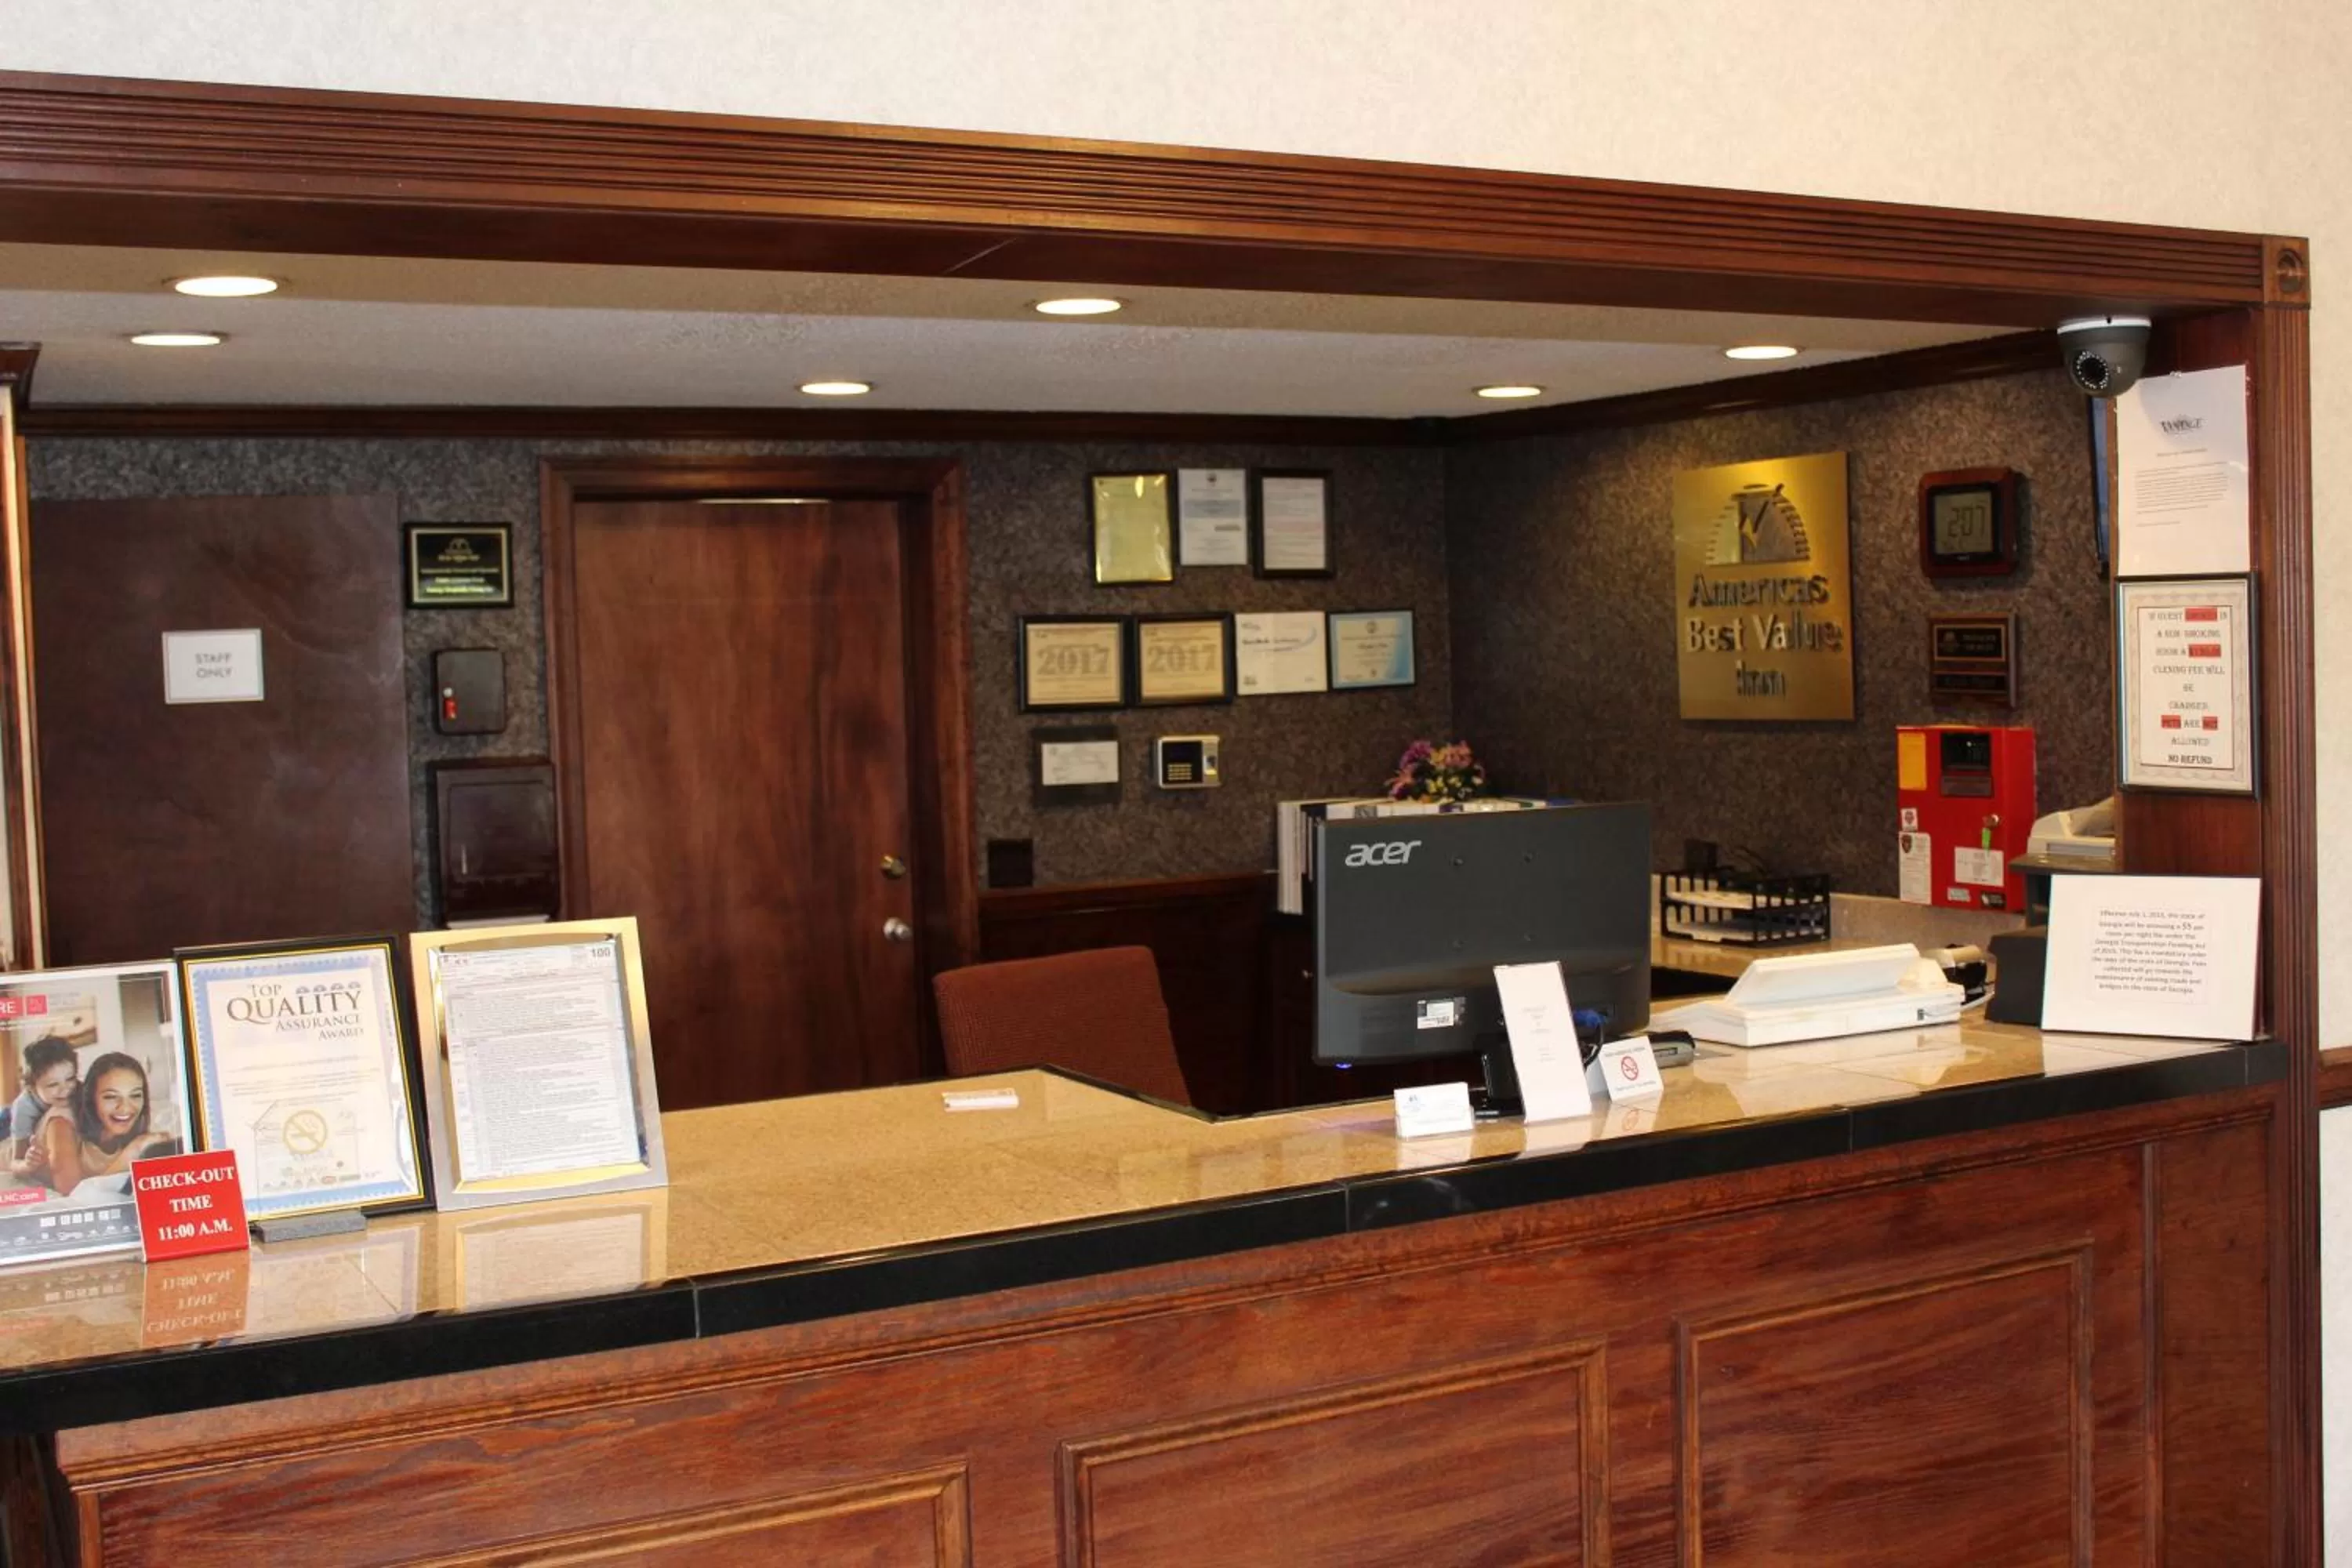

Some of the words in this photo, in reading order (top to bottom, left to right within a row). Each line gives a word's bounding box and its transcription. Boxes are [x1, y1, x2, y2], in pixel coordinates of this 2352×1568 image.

[1686, 616, 1746, 652] Best
[1751, 609, 1842, 652] Value
[194, 652, 233, 664] STAFF
[1036, 642, 1110, 675] 2017
[1147, 642, 1218, 672] 2017
[195, 666, 234, 678] ONLY
[2180, 755, 2213, 764] REFUND
[1345, 840, 1422, 866] acer
[591, 948, 611, 958] 100
[248, 983, 282, 997] TOP
[226, 990, 361, 1025] QUALITY
[276, 1014, 360, 1033] ASSURANCE
[318, 1028, 365, 1042] AWARD
[138, 1166, 234, 1191] CHECK-OUT
[169, 1194, 213, 1213] TIME
[158, 1222, 195, 1241] 11:00
[198, 1218, 234, 1236] A.M.
